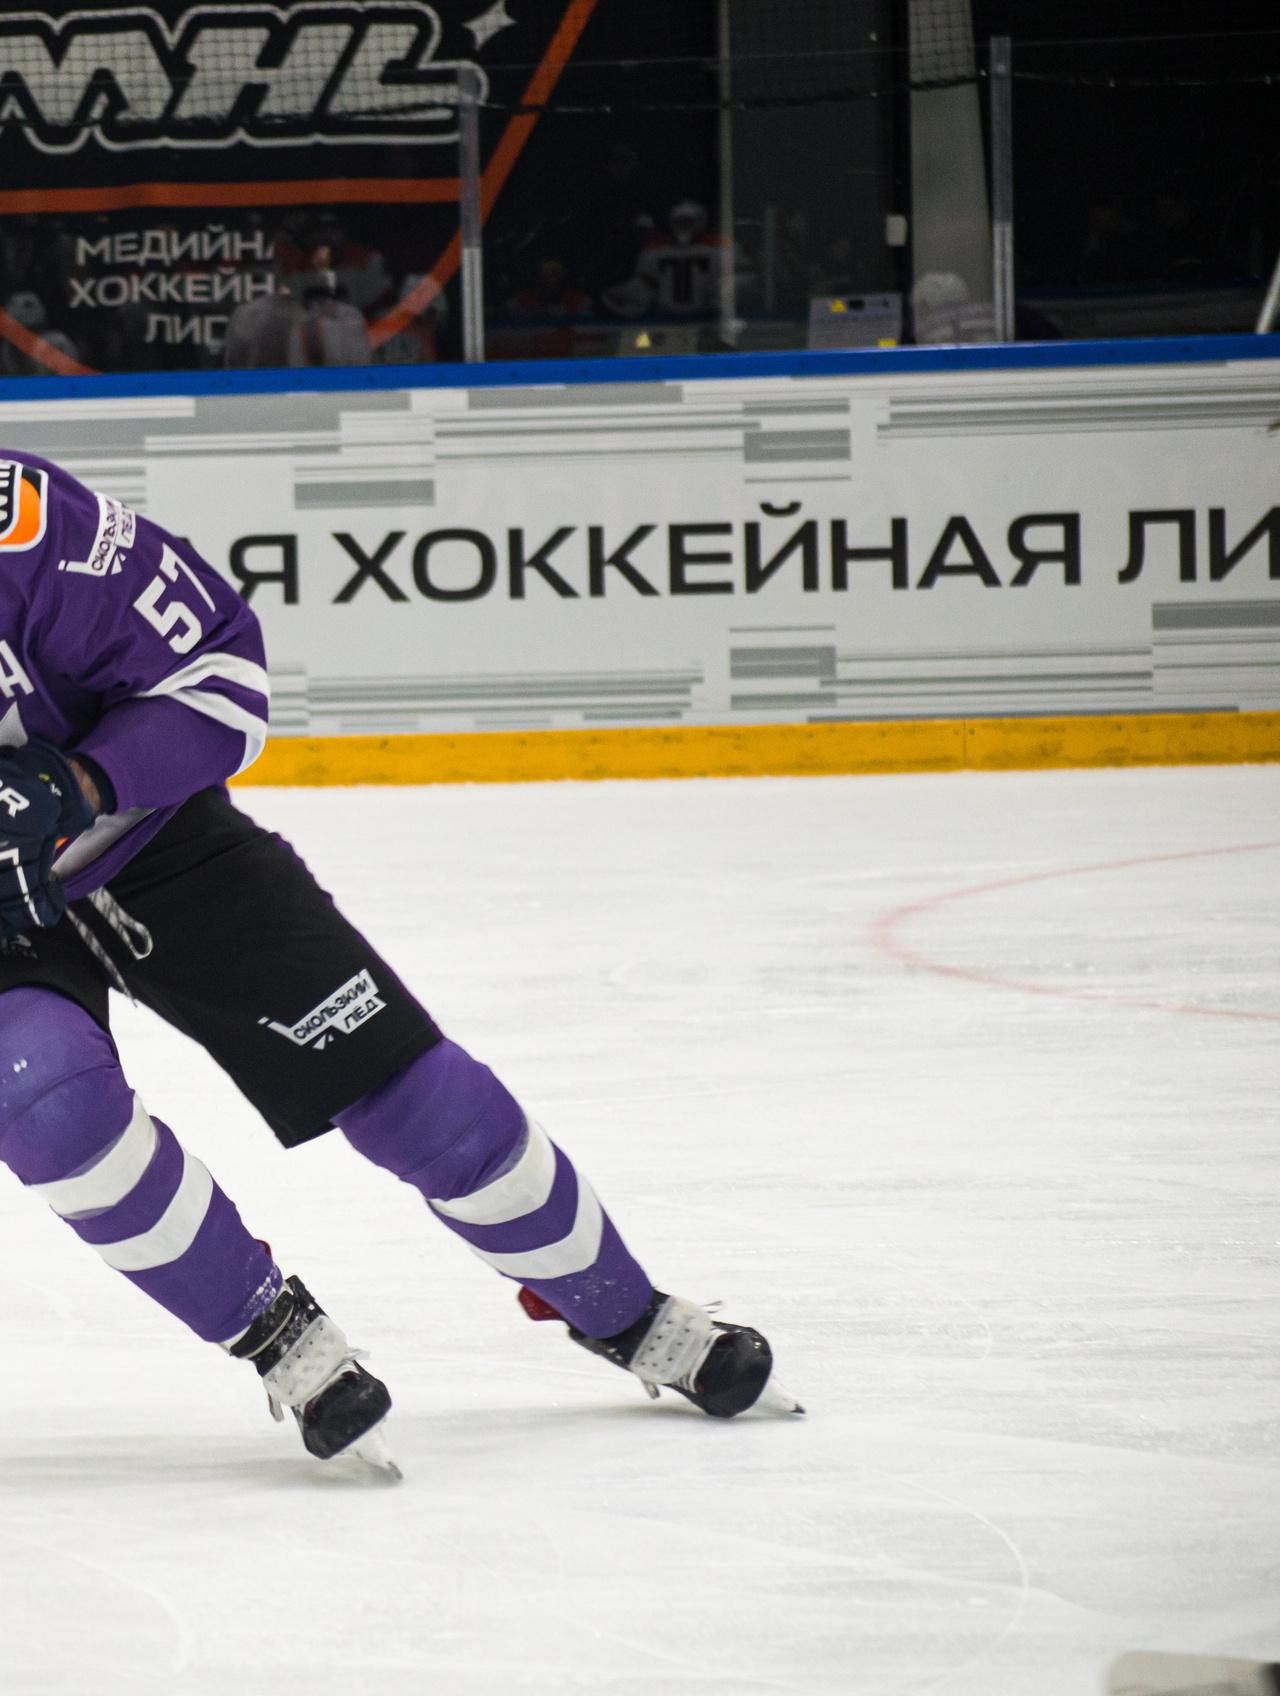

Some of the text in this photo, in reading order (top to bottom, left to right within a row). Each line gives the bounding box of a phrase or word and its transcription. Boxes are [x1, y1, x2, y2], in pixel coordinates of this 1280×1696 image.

[133, 542, 216, 655] 57
[331, 500, 1082, 604] ХОККЕЙНАЯ
[1117, 506, 1280, 585] ЛИ
